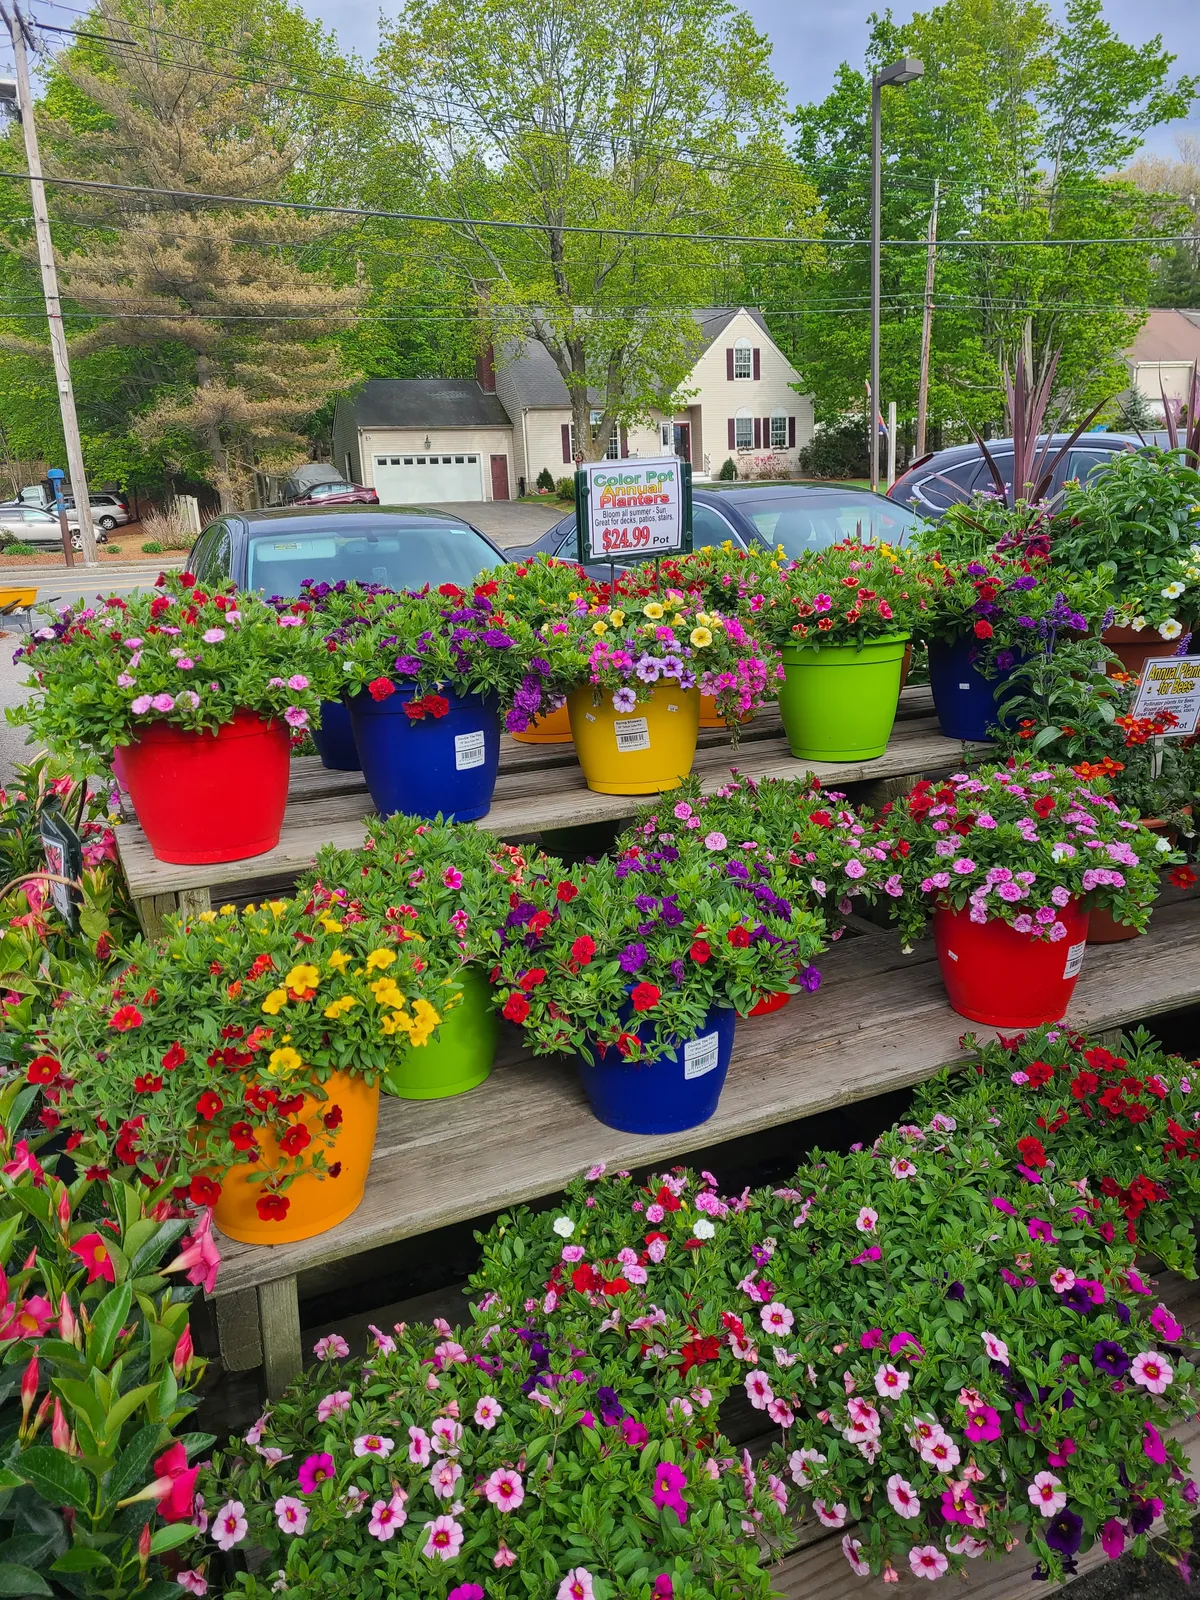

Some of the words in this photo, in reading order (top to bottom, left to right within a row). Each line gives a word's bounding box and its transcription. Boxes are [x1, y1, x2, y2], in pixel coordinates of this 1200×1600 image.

[593, 473, 641, 487] Color
[646, 470, 674, 483] Pot
[602, 481, 662, 496] Annual
[600, 493, 670, 508] Planters
[595, 518, 610, 526] Great
[620, 516, 638, 525] decks,
[639, 515, 656, 523] patios,
[658, 513, 674, 521] stairs.
[603, 510, 620, 518] Bloom
[630, 508, 651, 516] summer
[656, 506, 666, 514] Sun
[602, 526, 650, 552] $24.99
[653, 535, 669, 544] Pot
[1147, 663, 1180, 681] Annual
[1158, 680, 1172, 695] for
[1171, 678, 1193, 694] Bees
